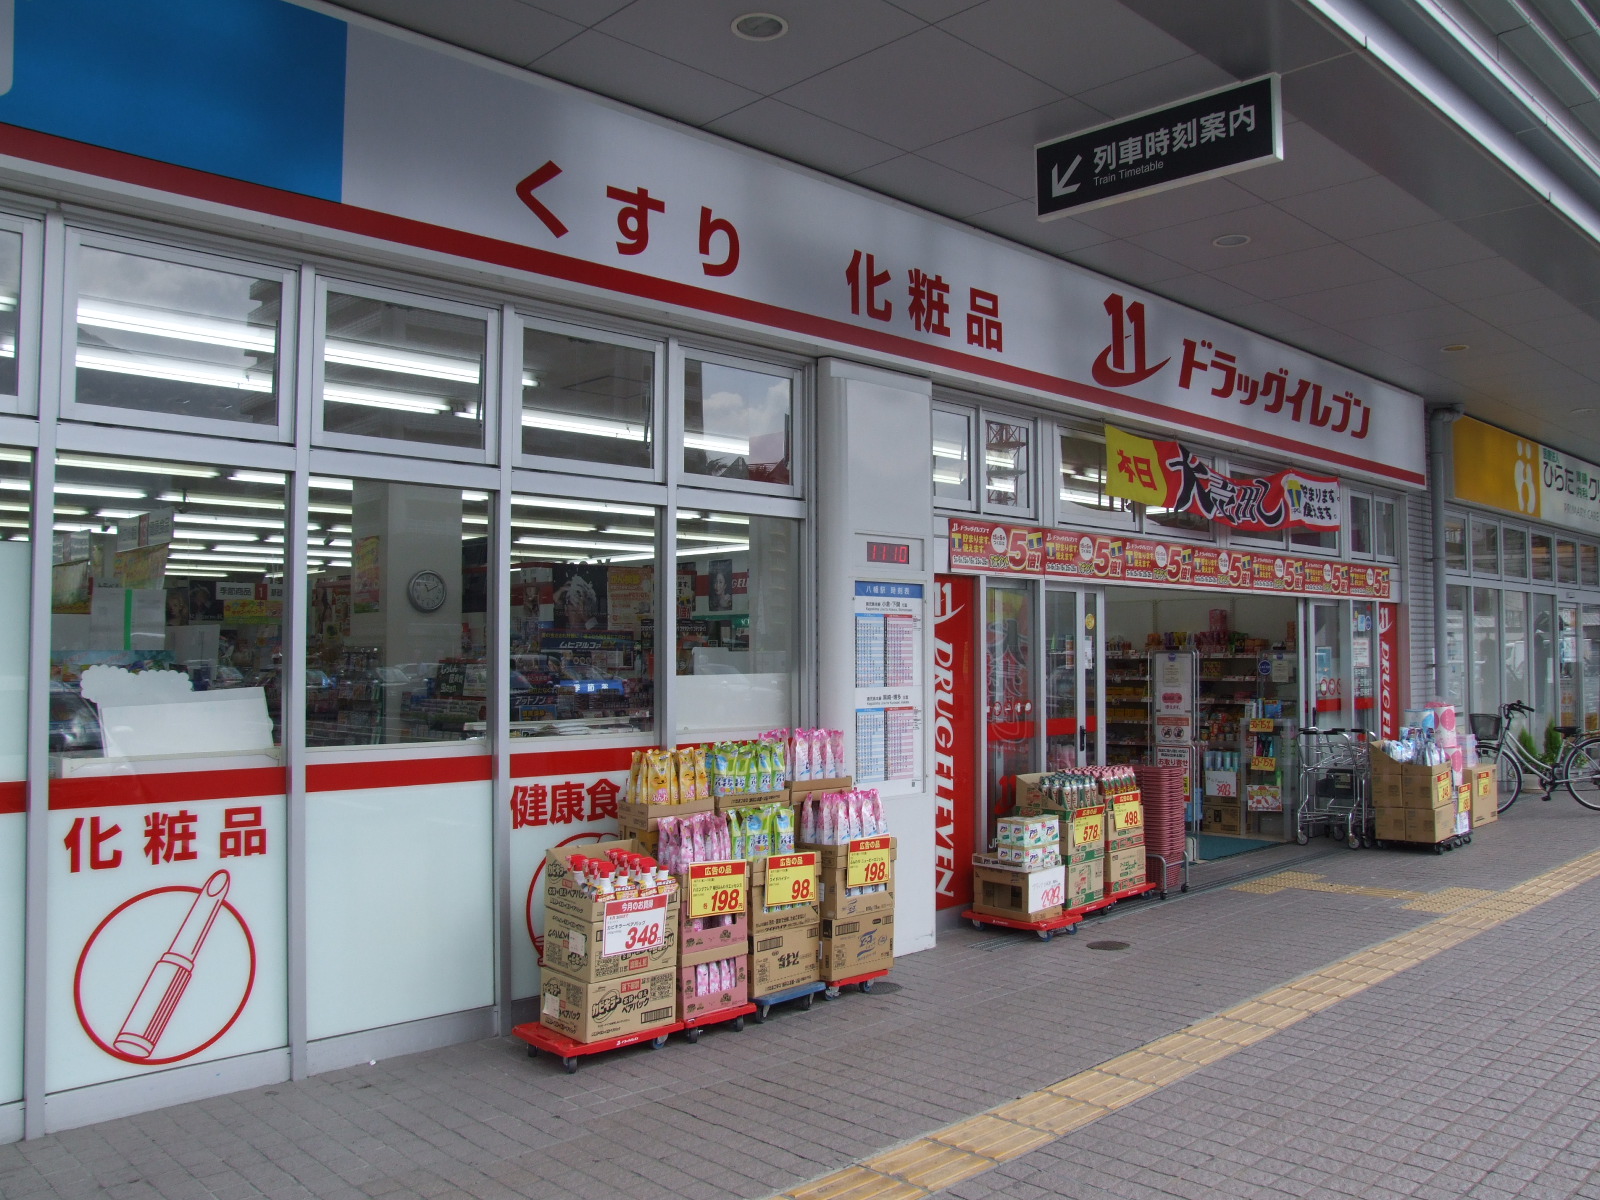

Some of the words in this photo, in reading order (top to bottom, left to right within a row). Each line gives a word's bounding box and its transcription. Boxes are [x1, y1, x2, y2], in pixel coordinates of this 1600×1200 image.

[1093, 104, 1256, 174] 列車時刻案内
[1094, 173, 1116, 187] Train
[1118, 160, 1164, 181] Timetable
[515, 159, 740, 277] くすり
[845, 249, 1003, 353] 化粧品
[1178, 338, 1371, 439] ドラッグイレブン
[1116, 449, 1158, 491] 祝
[1166, 443, 1285, 527] 大売出し
[1543, 461, 1574, 495] ひらた
[935, 641, 954, 749] DRUG
[1382, 641, 1391, 709] DRUG
[510, 778, 621, 829] 健康食
[935, 754, 955, 897] ELEVEN
[1083, 824, 1099, 842] 578
[1124, 810, 1138, 826] 498
[64, 806, 267, 873] 化粧品
[779, 856, 803, 867] 広告の品
[859, 840, 880, 850] 広告の品
[704, 864, 732, 876] 広告の品
